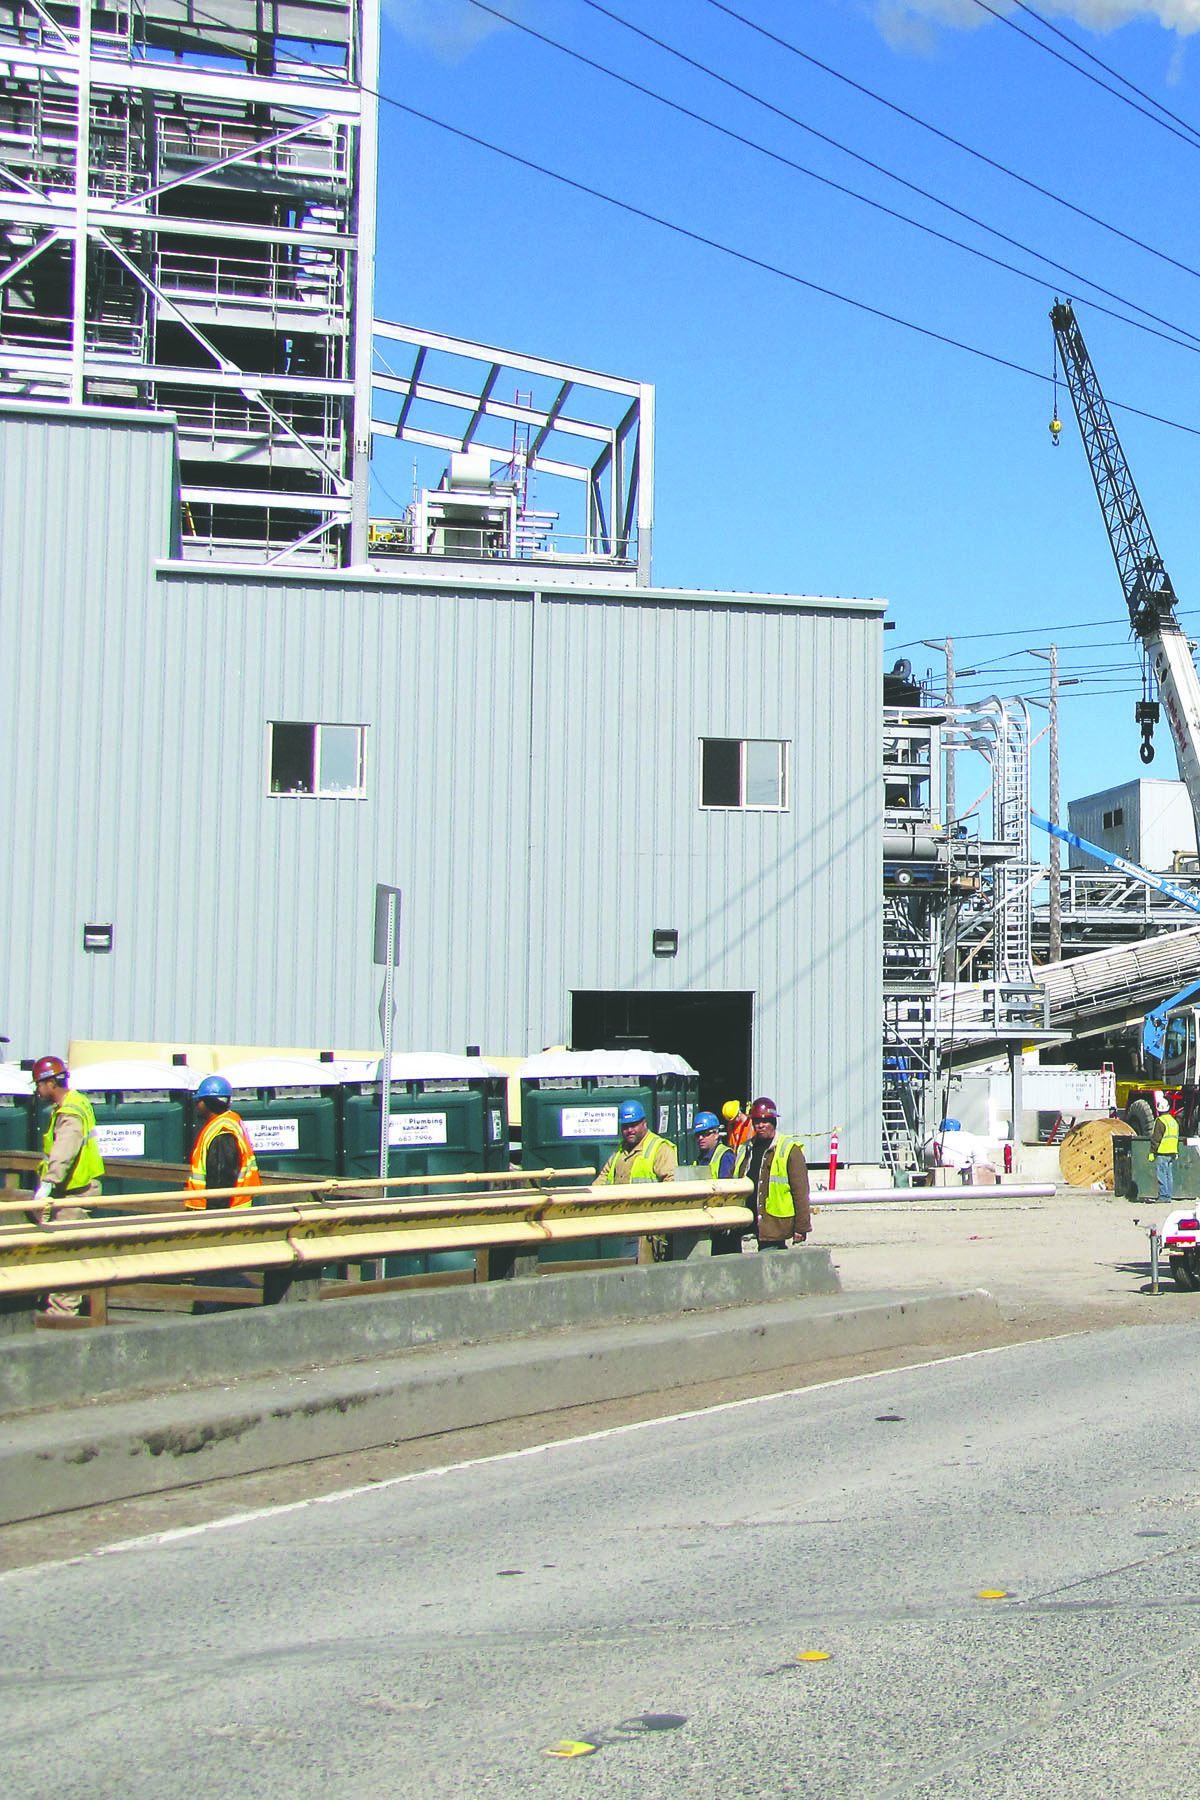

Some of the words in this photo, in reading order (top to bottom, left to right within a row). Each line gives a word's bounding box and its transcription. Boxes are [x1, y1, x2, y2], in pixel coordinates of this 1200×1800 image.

[583, 1111, 616, 1120] Plumbing
[408, 1117, 444, 1126] Plumbing
[260, 1123, 296, 1132] Plumbing
[106, 1129, 142, 1138] Plumbing
